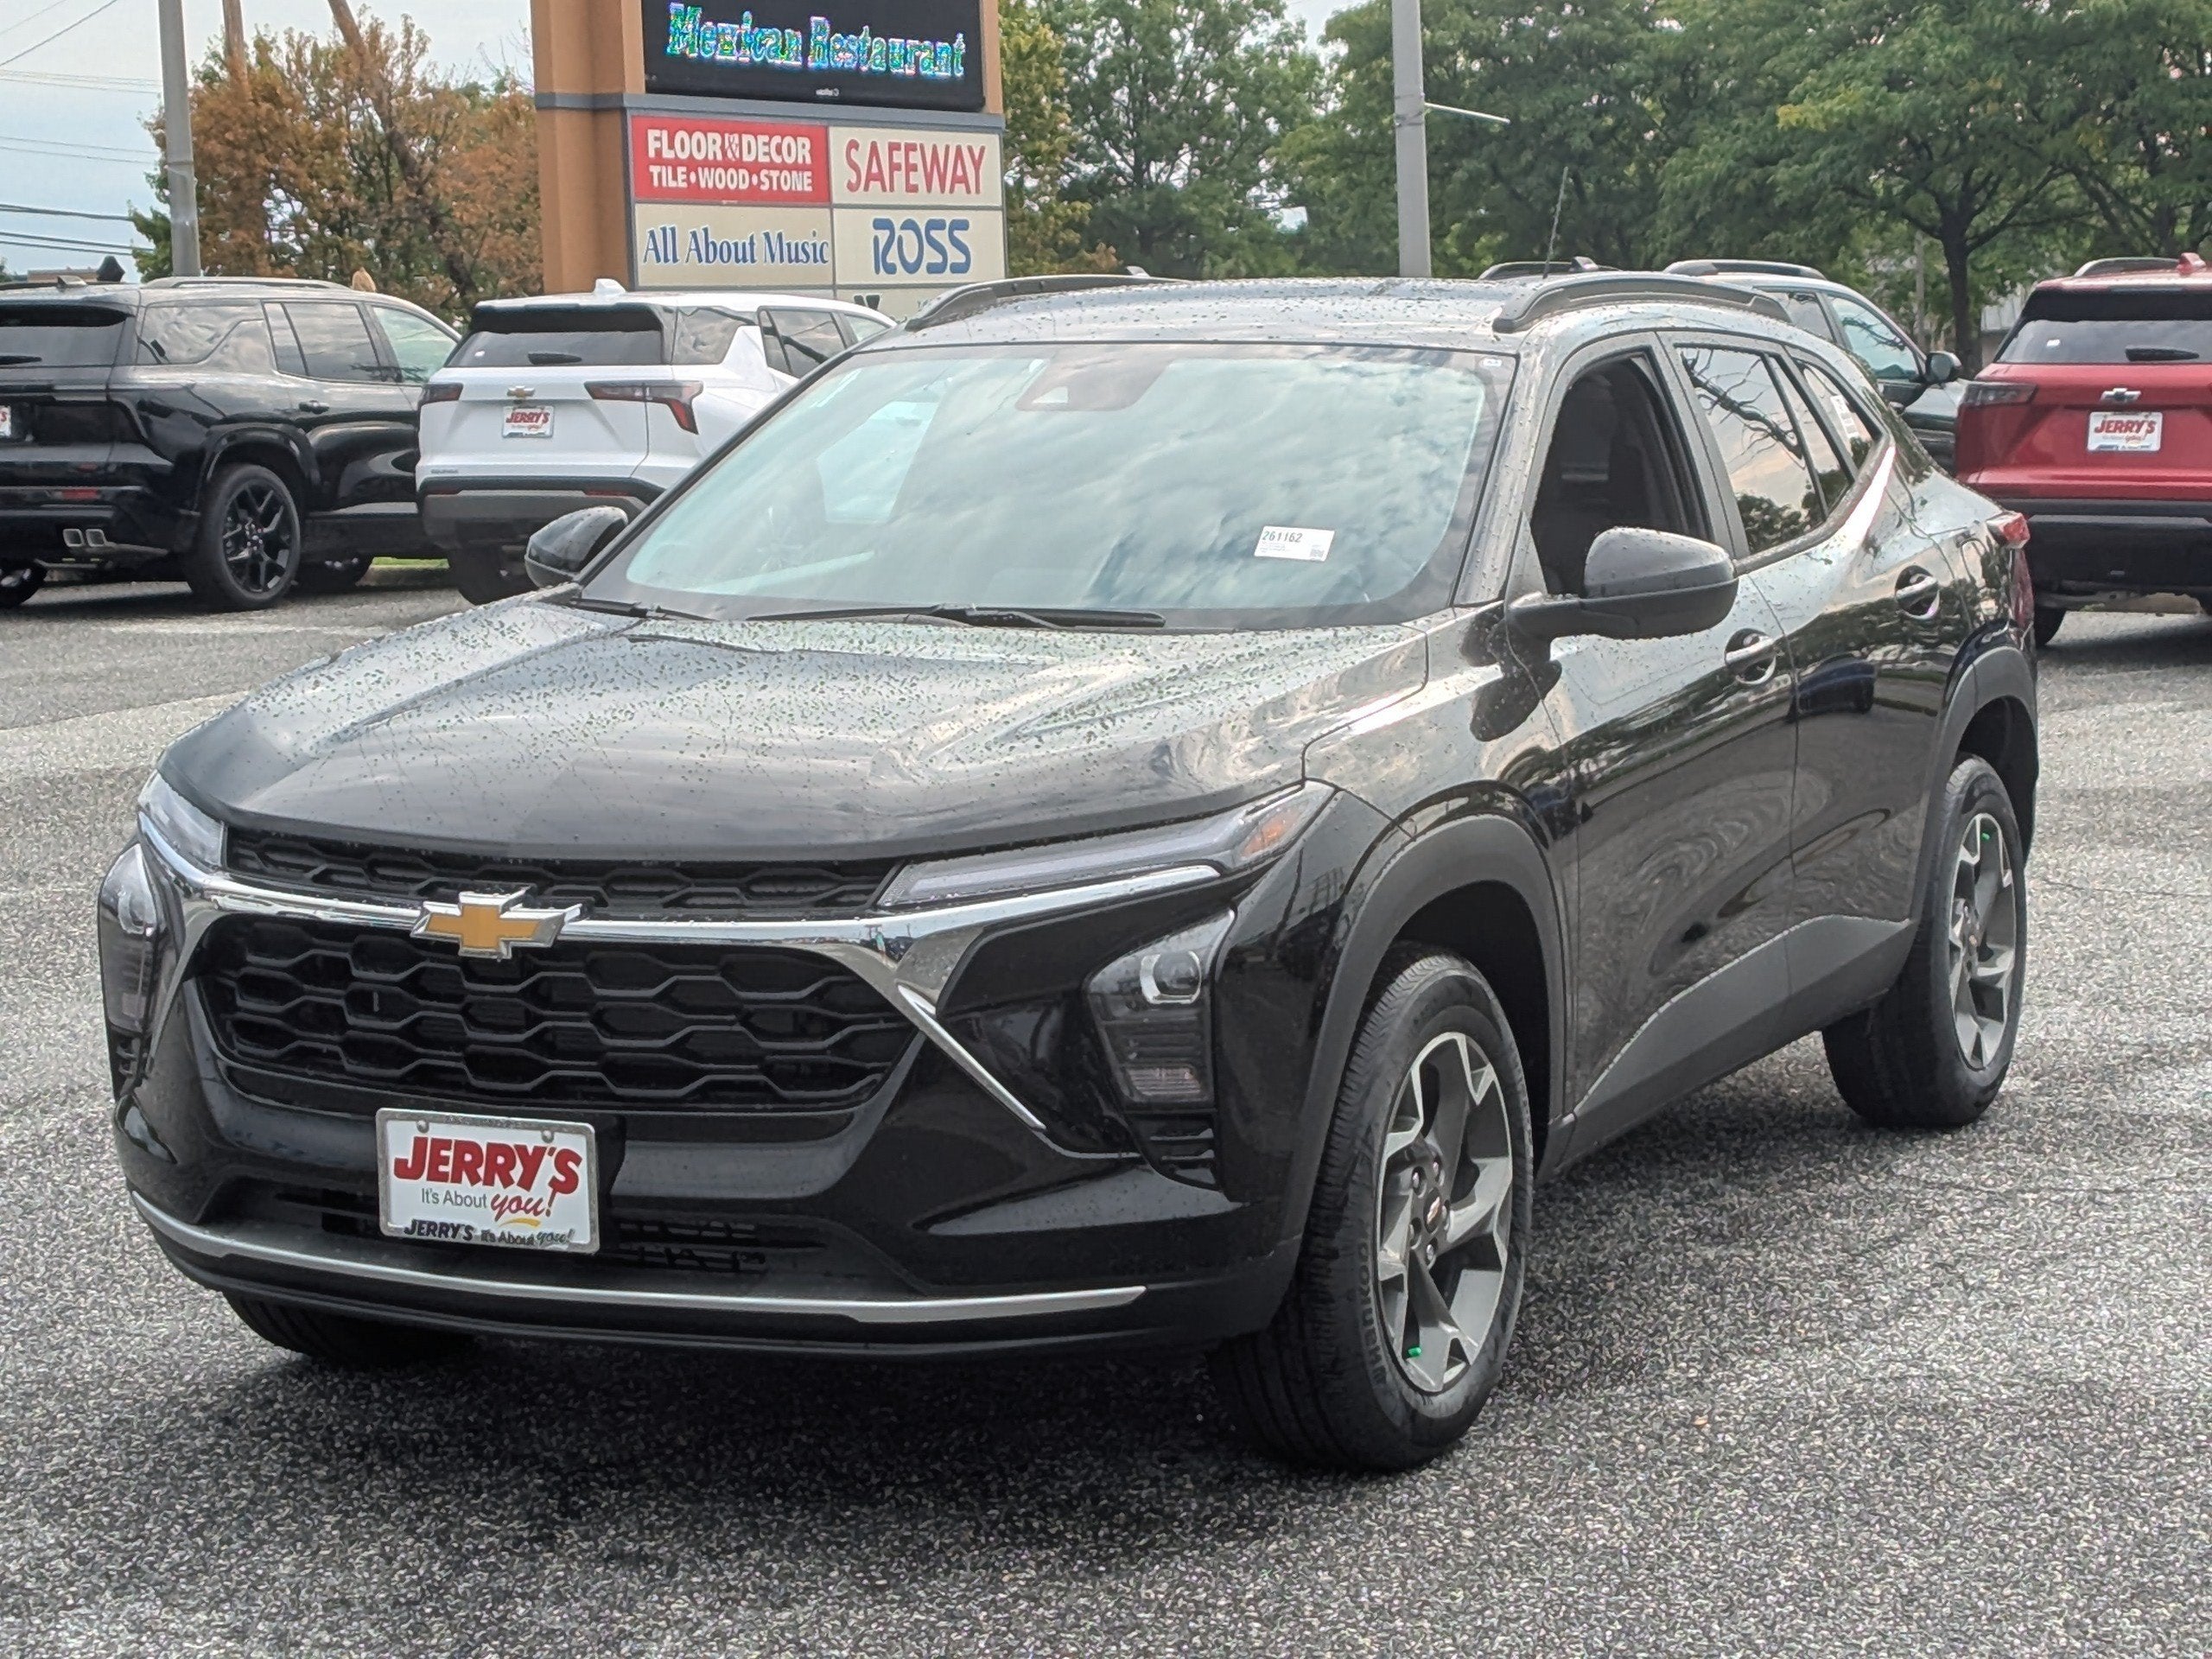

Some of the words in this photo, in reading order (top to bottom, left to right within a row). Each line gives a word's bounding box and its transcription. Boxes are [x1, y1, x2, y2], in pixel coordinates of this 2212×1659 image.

[666, 2, 803, 66] Mexican
[807, 16, 966, 77] Restaurant
[647, 129, 722, 161] FLOOR
[741, 133, 812, 164] DECOR
[649, 164, 688, 188] TILE
[697, 166, 750, 190] WOOD
[760, 168, 813, 192] STONE
[845, 139, 986, 194] SAFEWAY
[642, 224, 680, 264] All
[684, 224, 758, 264] About
[762, 228, 830, 264] Music
[872, 218, 972, 276] ROSS
[2094, 419, 2157, 434] JERRY'S
[1262, 530, 1303, 543] 261162
[394, 1136, 583, 1195] JERRY'S
[421, 1188, 440, 1205] It's
[442, 1190, 487, 1209] About
[491, 1190, 557, 1223] you!
[404, 1218, 476, 1242] JERRY'S
[498, 1231, 535, 1246] About
